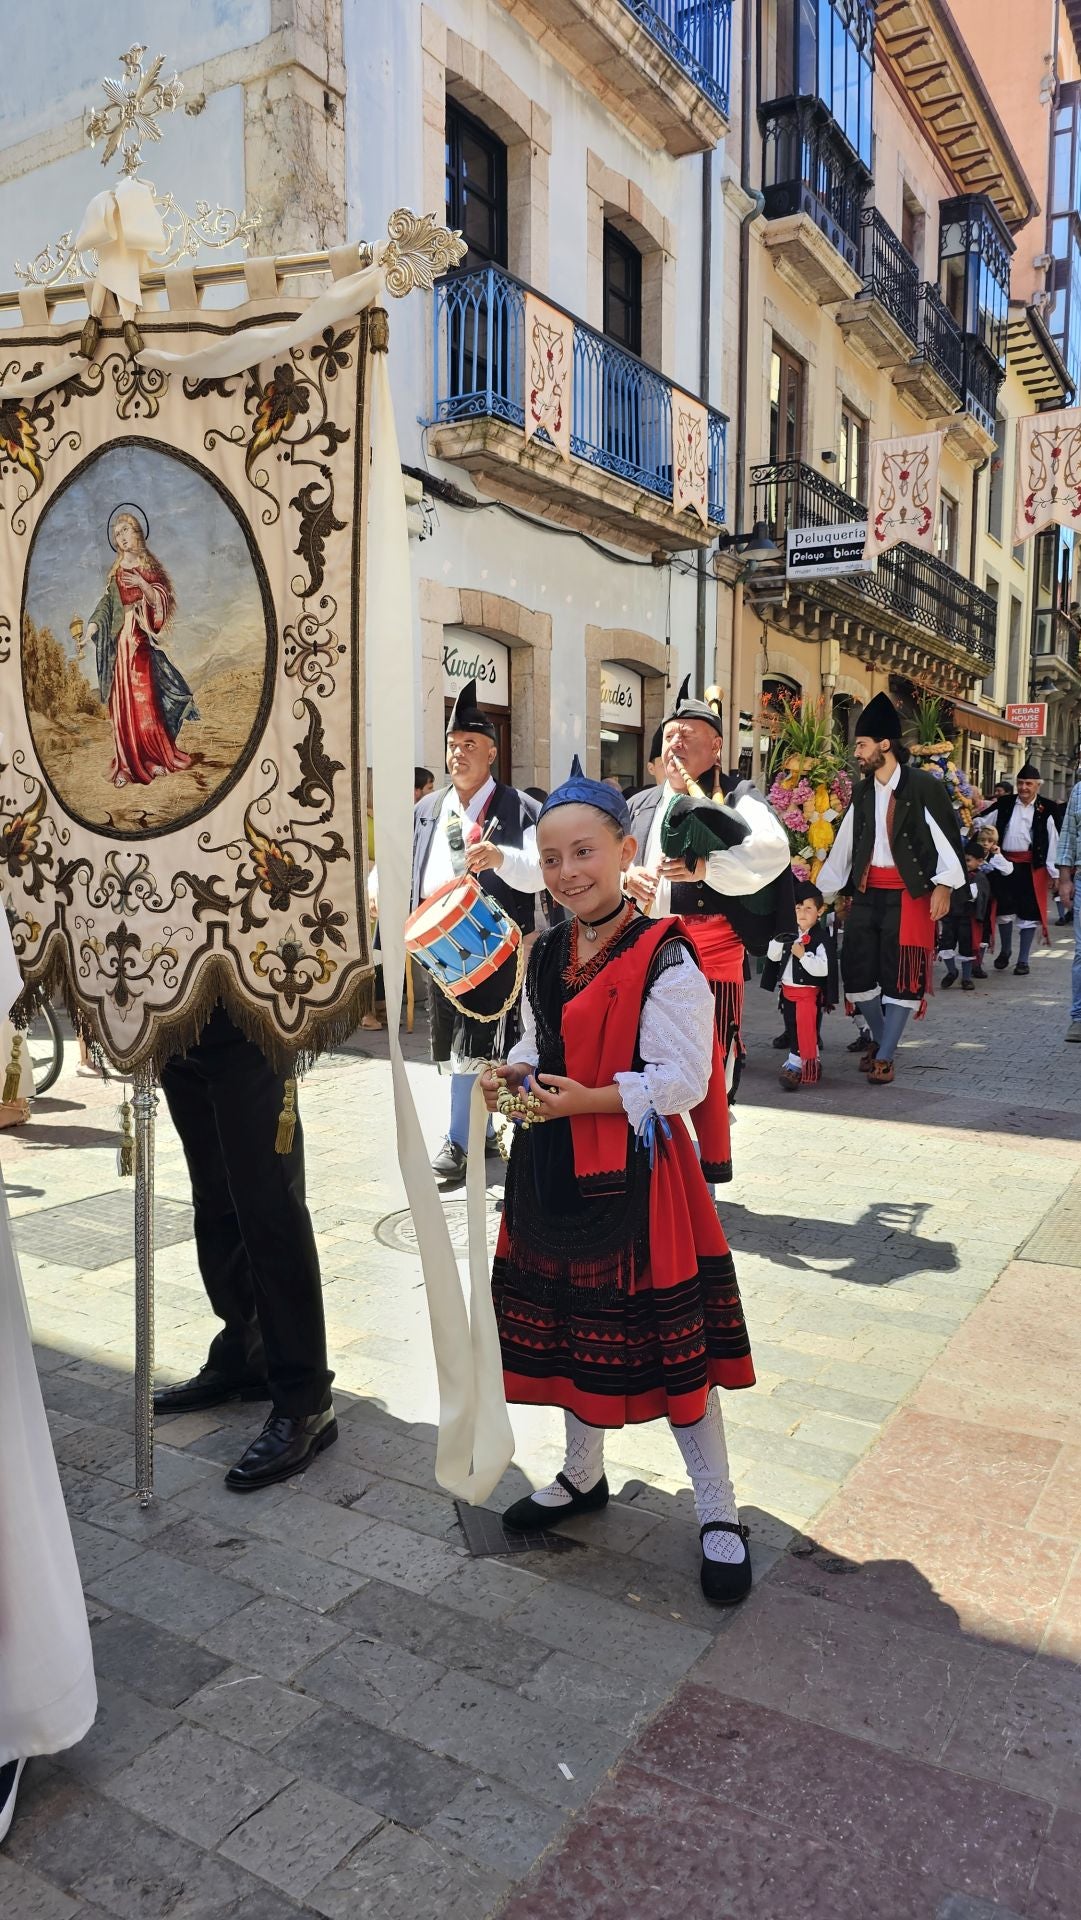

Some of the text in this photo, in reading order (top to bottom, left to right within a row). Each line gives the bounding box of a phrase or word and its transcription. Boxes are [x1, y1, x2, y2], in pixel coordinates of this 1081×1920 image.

[600, 680, 632, 708] urde's
[1011, 707, 1040, 715] KEBAB
[1011, 714, 1040, 722] HOUSE
